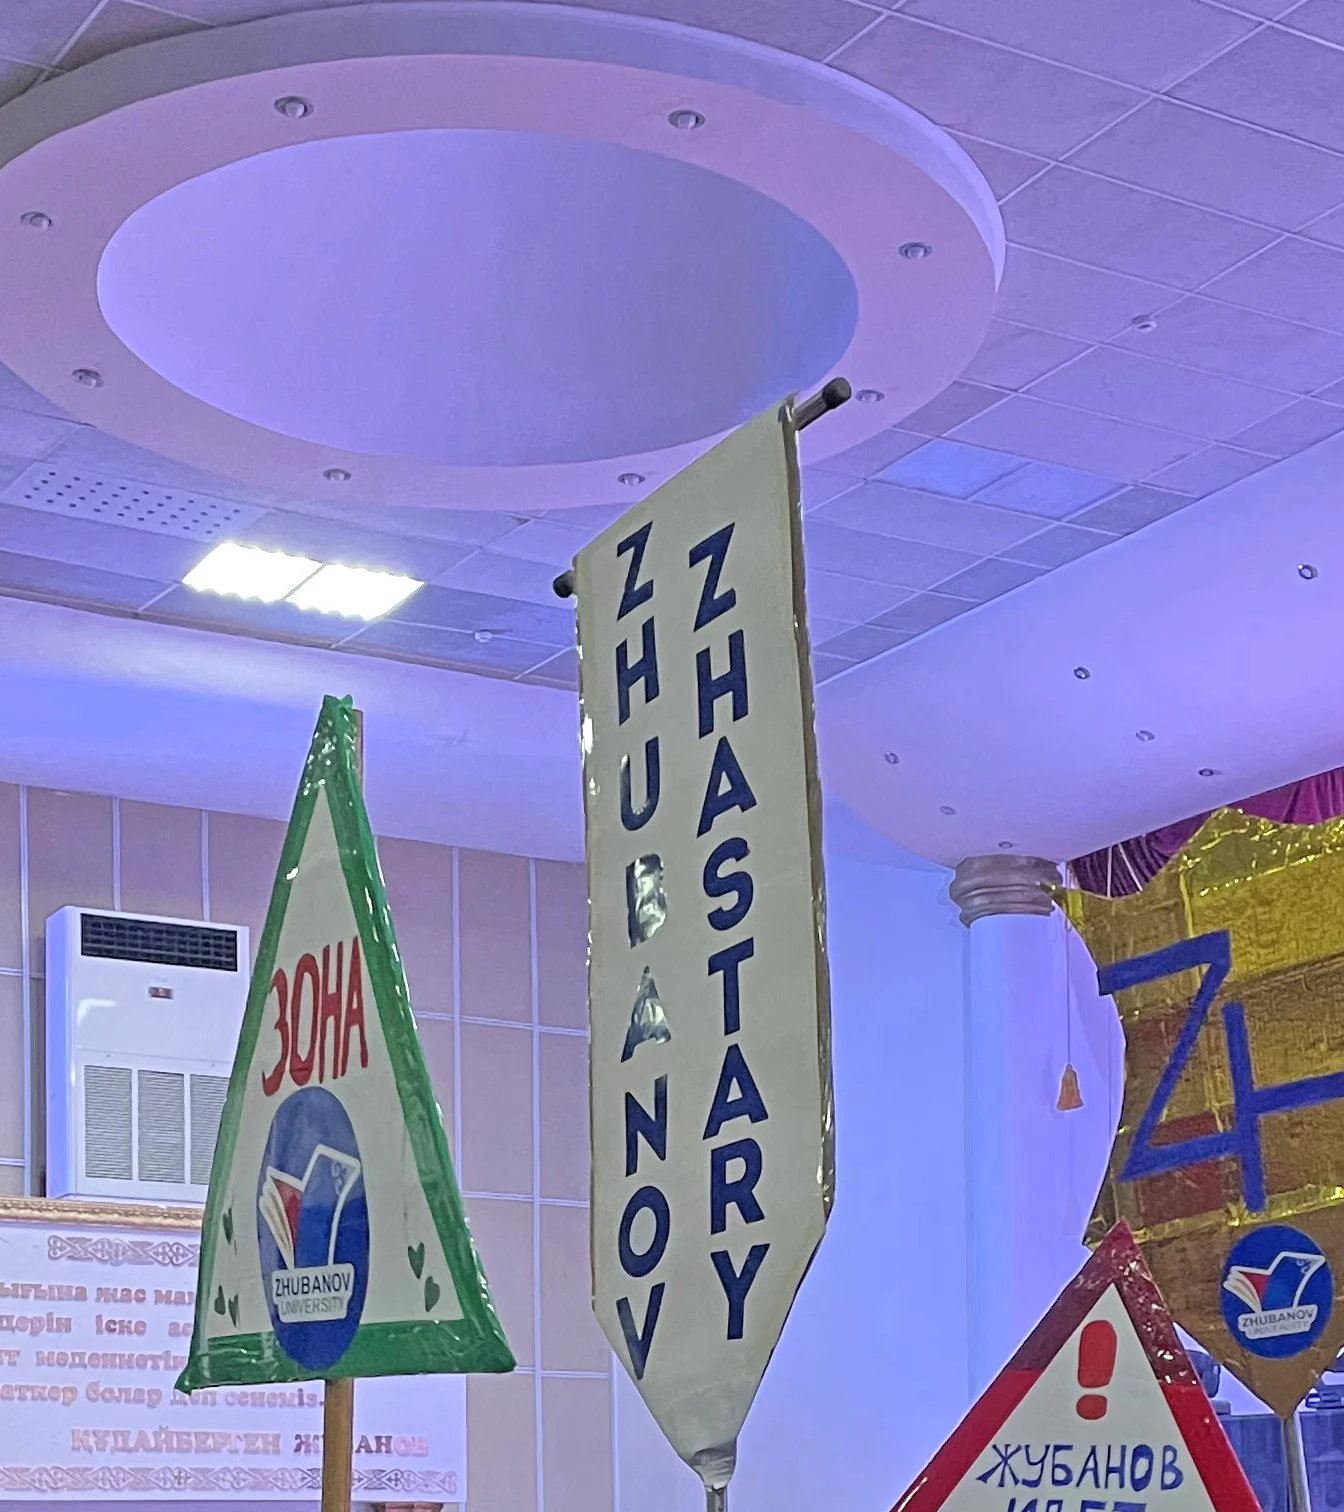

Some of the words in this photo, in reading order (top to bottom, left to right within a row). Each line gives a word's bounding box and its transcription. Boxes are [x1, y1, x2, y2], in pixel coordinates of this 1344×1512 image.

[688, 522, 770, 1341] ZHASTARY
[616, 520, 671, 1380] ZHUBANOV
[262, 936, 368, 1097] ЗОНА
[95, 1286, 147, 1304] жас
[275, 1272, 351, 1297] ZHUBANOV
[280, 1295, 346, 1316] UNIVERSITY
[1242, 1308, 1315, 1328] ZHUBANOV
[294, 1433, 429, 1457] ЖАНОВ
[975, 1443, 1184, 1493] ЖУБАНОВ
